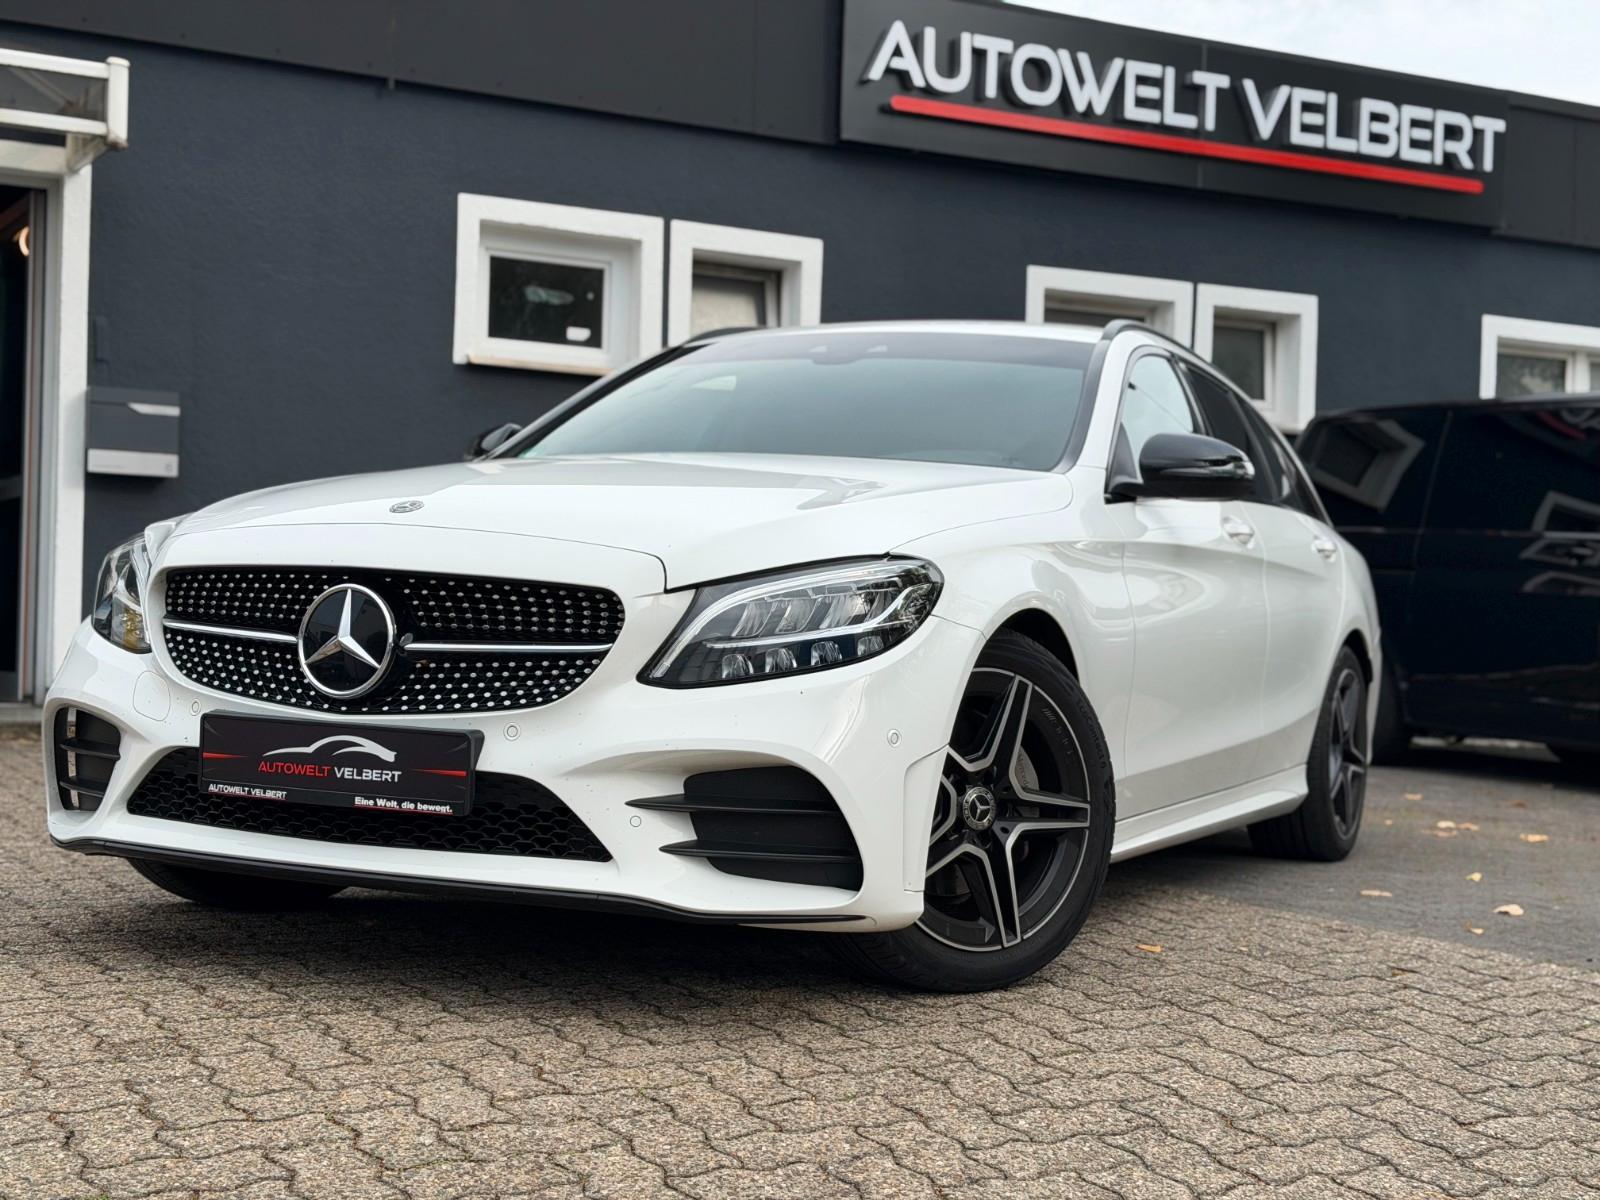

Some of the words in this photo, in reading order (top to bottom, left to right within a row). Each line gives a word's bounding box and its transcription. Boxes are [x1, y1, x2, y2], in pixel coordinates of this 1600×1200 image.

[867, 20, 1230, 132] AUTOWELT
[1243, 79, 1507, 173] VELBERT
[258, 761, 331, 777] AUTOWELT
[334, 766, 402, 782] VELBERT
[208, 783, 249, 795] AUTOWELT
[250, 788, 287, 799] VELBERT
[354, 796, 374, 806] Eine
[401, 802, 415, 810] die
[417, 802, 453, 813] bewegt.
